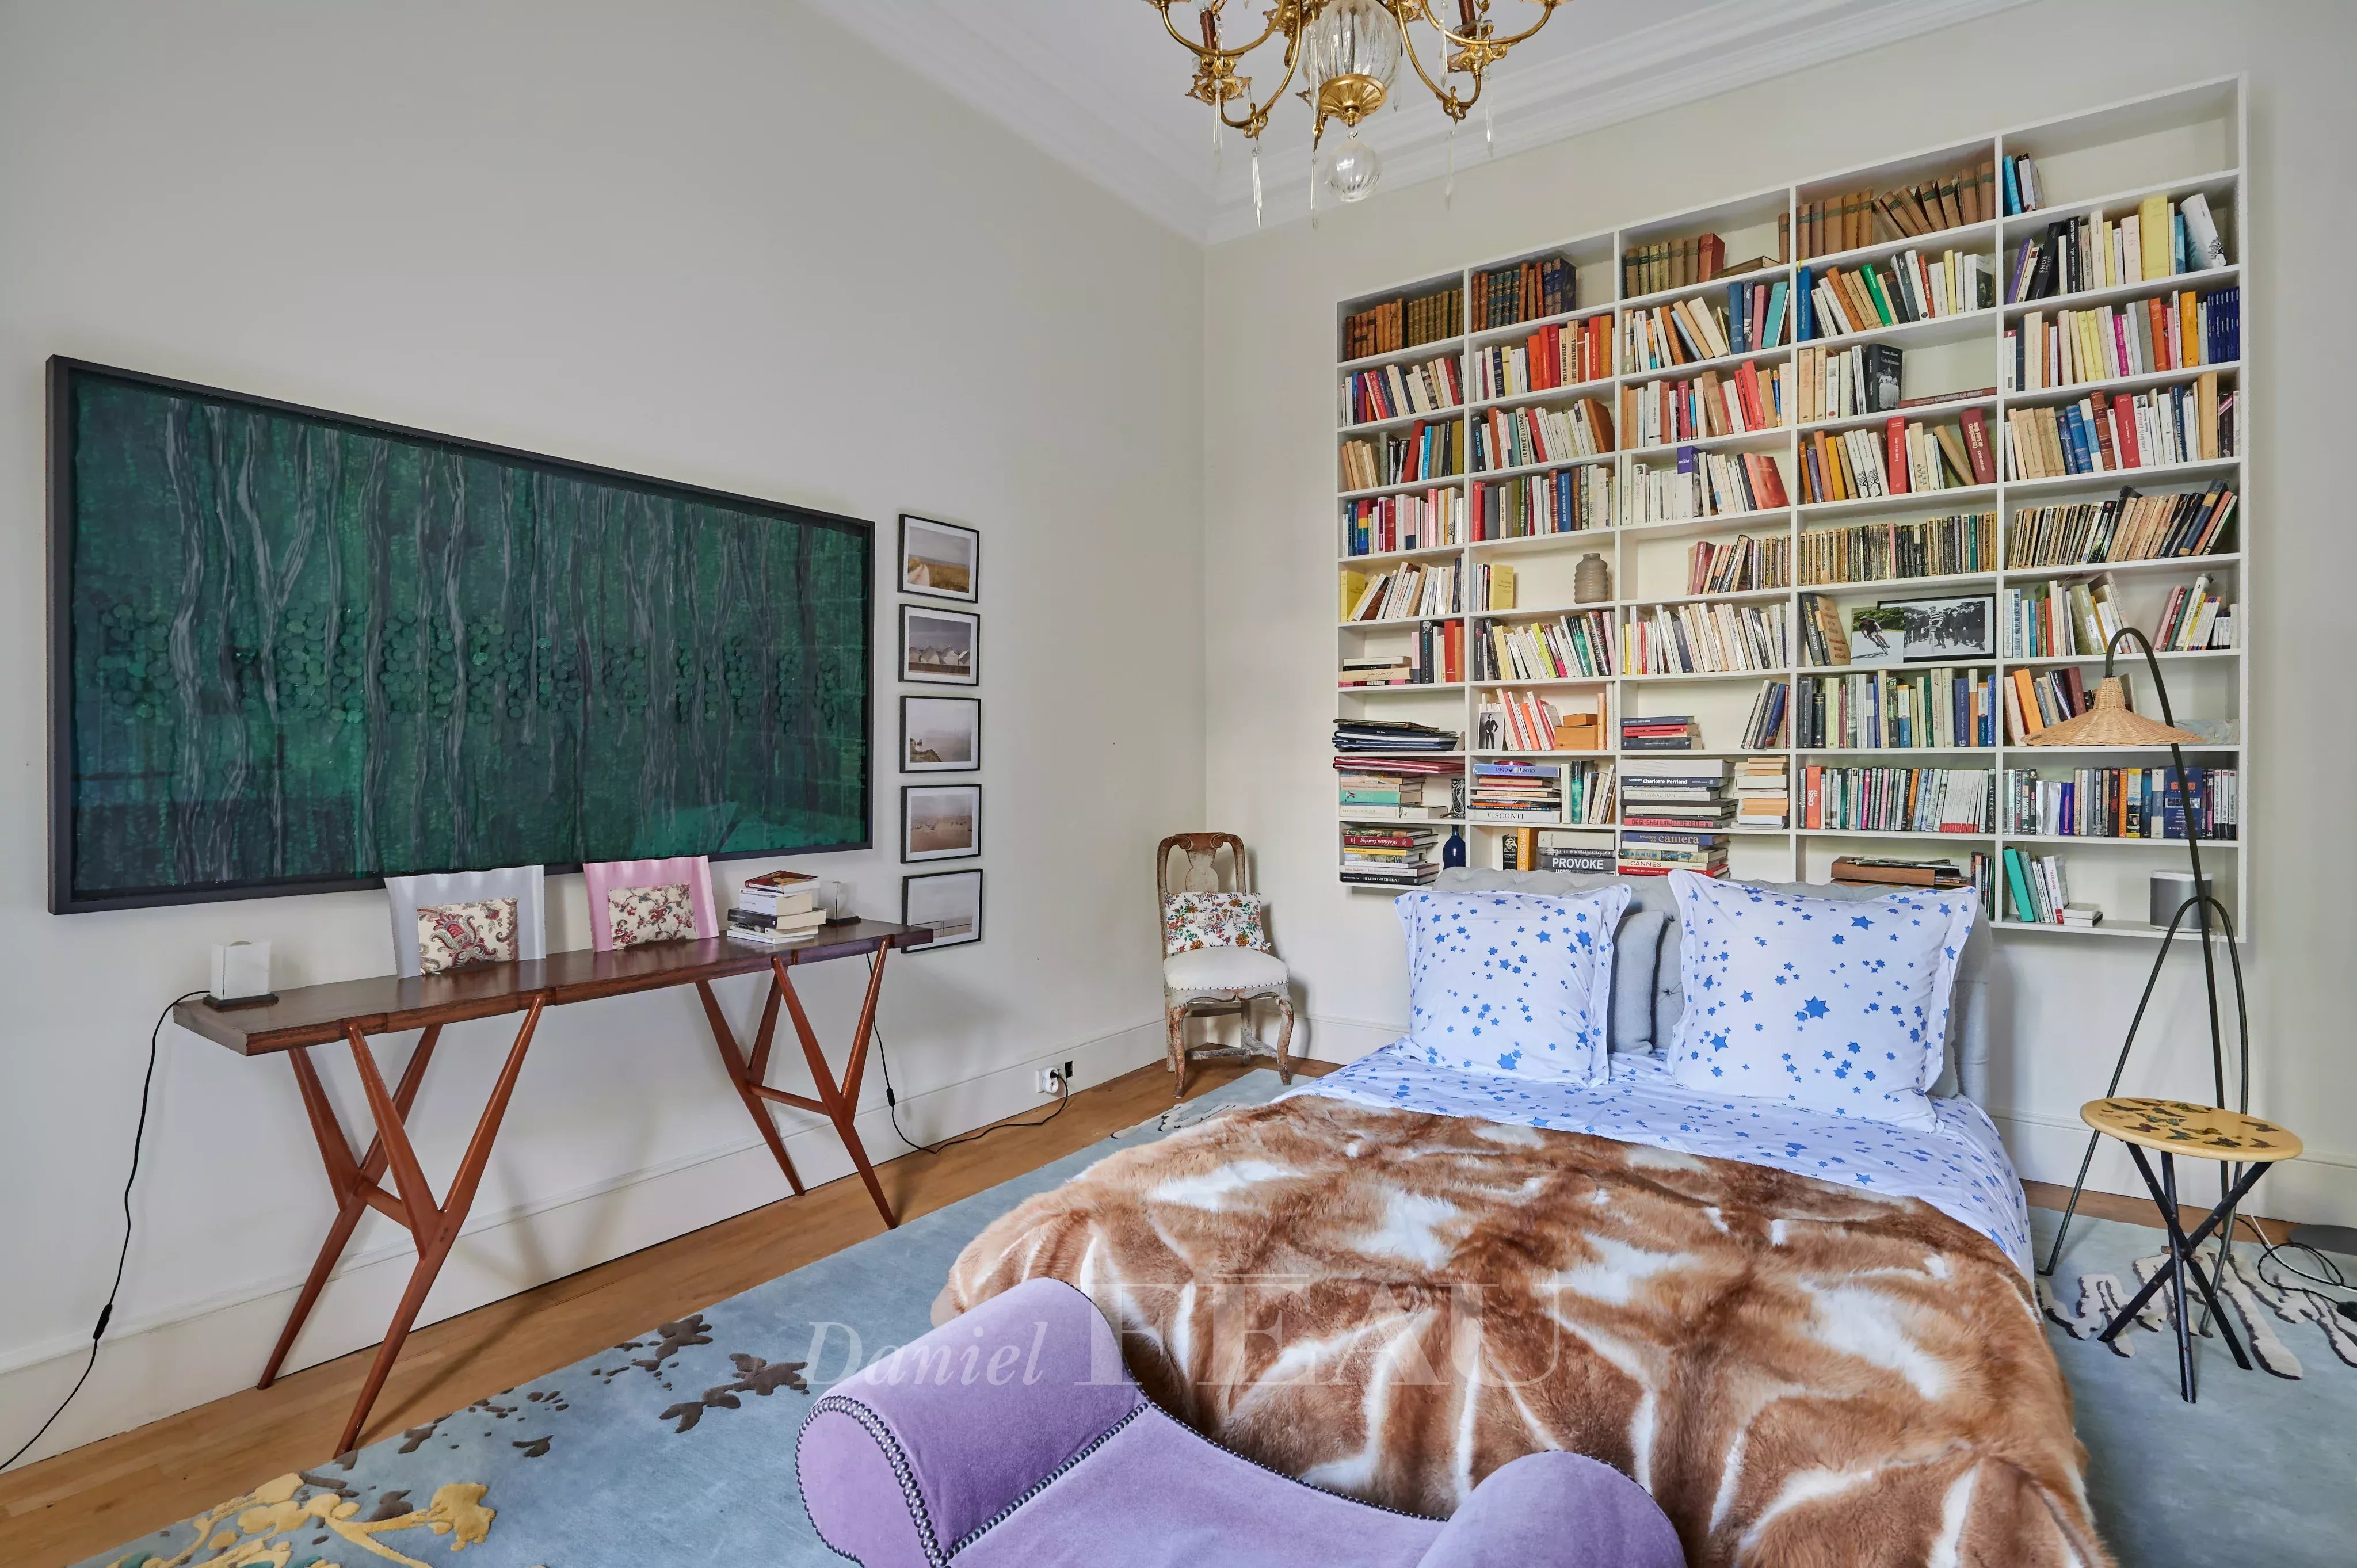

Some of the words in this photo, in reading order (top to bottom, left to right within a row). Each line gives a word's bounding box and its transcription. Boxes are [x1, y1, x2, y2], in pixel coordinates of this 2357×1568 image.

[2039, 255, 2047, 273] SNOB
[1658, 835, 1699, 844] camera
[1552, 857, 1604, 869] PROVOKE
